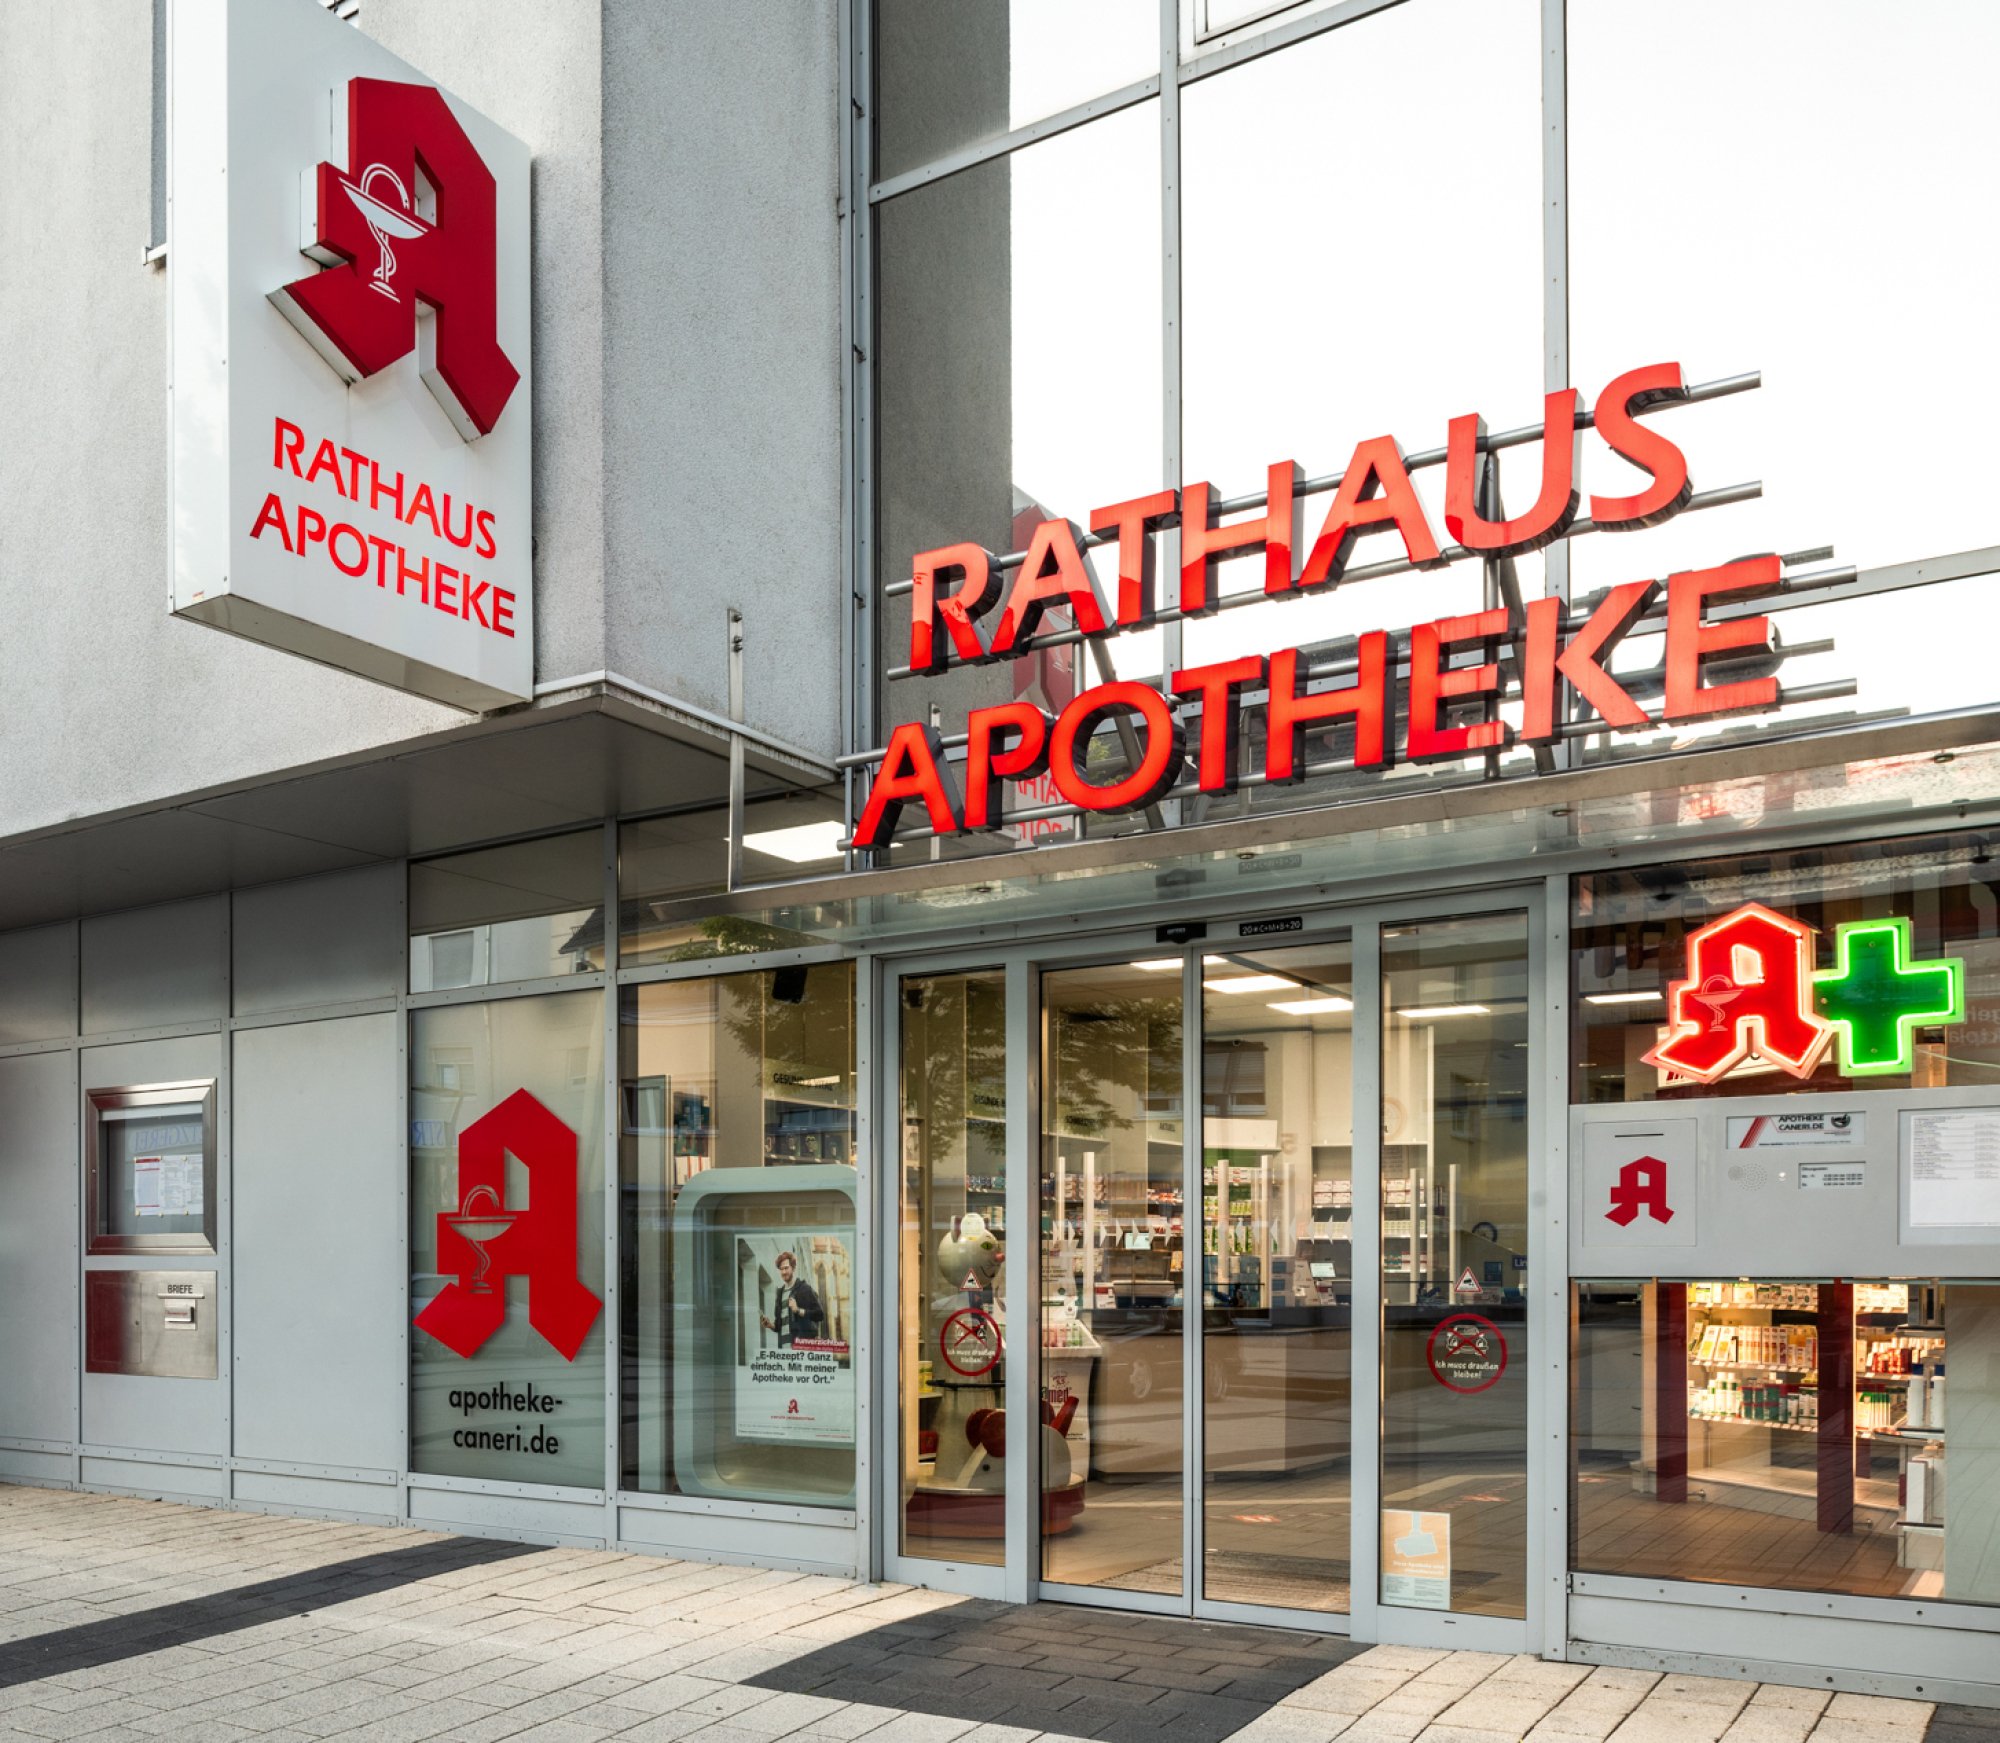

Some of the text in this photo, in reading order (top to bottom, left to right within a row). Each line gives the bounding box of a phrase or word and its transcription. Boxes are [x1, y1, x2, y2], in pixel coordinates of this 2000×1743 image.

[274, 417, 496, 559] RATHAUS
[911, 362, 1692, 674] RATHAUS
[250, 492, 516, 638] APOTHEKE
[852, 555, 1784, 848] APOTHEKE
[167, 1284, 193, 1294] BRIEFE
[751, 1362, 837, 1373] einfach. Mit meiner
[807, 1352, 831, 1361] Ganz
[752, 1372, 793, 1383] Apotheke
[796, 1375, 810, 1383] vor
[449, 1381, 563, 1417] apotheke-
[453, 1424, 559, 1455] caneri.de
